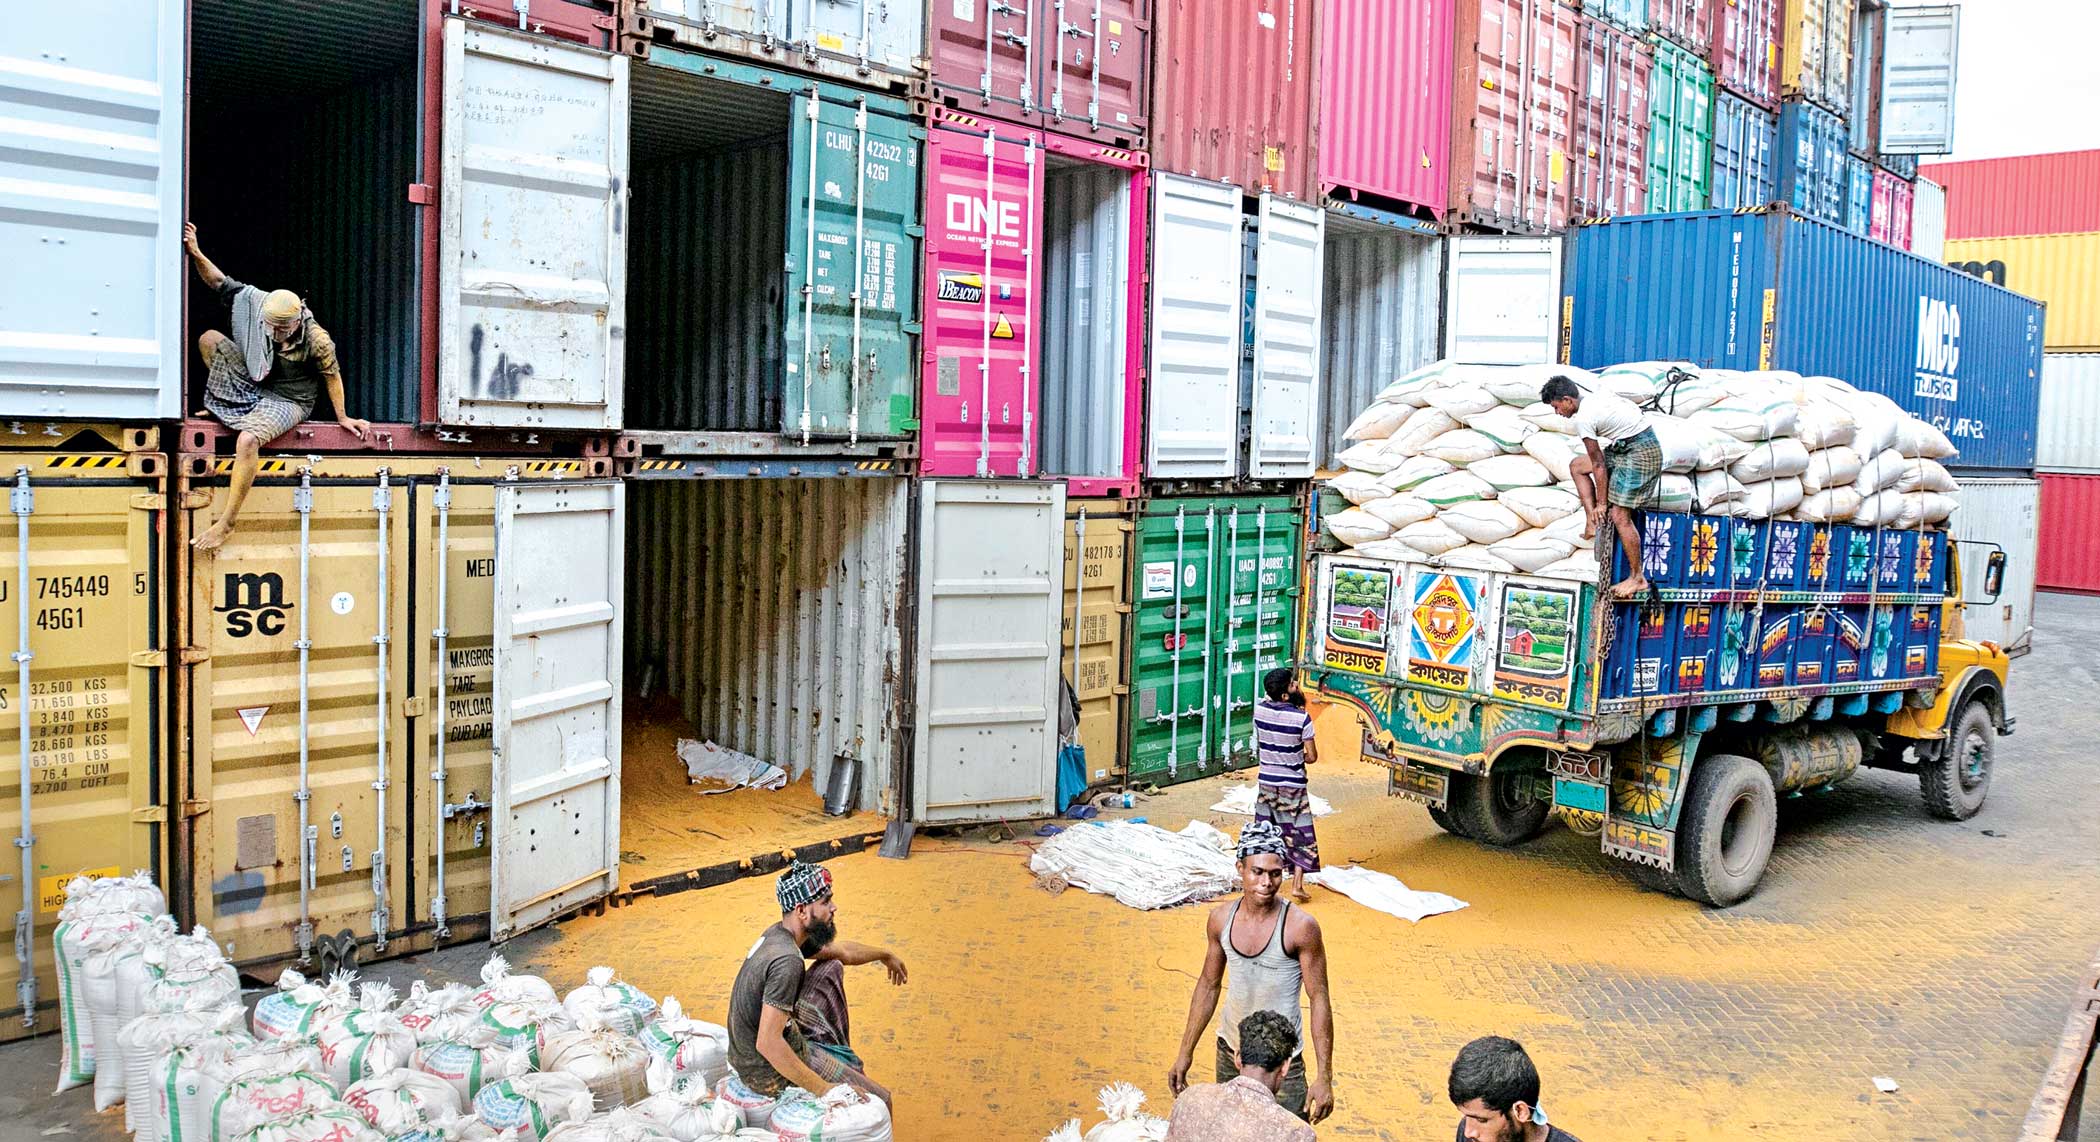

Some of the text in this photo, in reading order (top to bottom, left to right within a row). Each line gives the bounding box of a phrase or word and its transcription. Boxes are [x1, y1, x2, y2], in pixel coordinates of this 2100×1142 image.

[826, 131, 852, 151] CLHU
[867, 140, 902, 162] 422522
[866, 162, 889, 182] 42G1
[946, 193, 1020, 238] ONE
[967, 236, 994, 245] NETWK
[945, 280, 982, 302] BEACON
[1916, 295, 1960, 375] MCC
[1084, 546, 1113, 560] 482178
[1083, 564, 1102, 578] 42G1
[36, 573, 146, 599] 745449 5
[36, 607, 83, 631] 45G1
[1326, 650, 1384, 672] নামাজ
[1409, 661, 1469, 686] কায়েম
[31, 678, 107, 695] 32.500 KGS
[452, 675, 475, 692] TARE
[32, 693, 108, 709] 71.650 LBS
[450, 697, 492, 718] PAYLOAD
[86, 707, 108, 720] KGS
[85, 721, 108, 732] LBS
[32, 734, 107, 752] 28.660 KGS
[86, 749, 109, 761] LBS
[42, 763, 109, 781] 76.4 CUM
[33, 776, 109, 795] 2.700 CUFT
